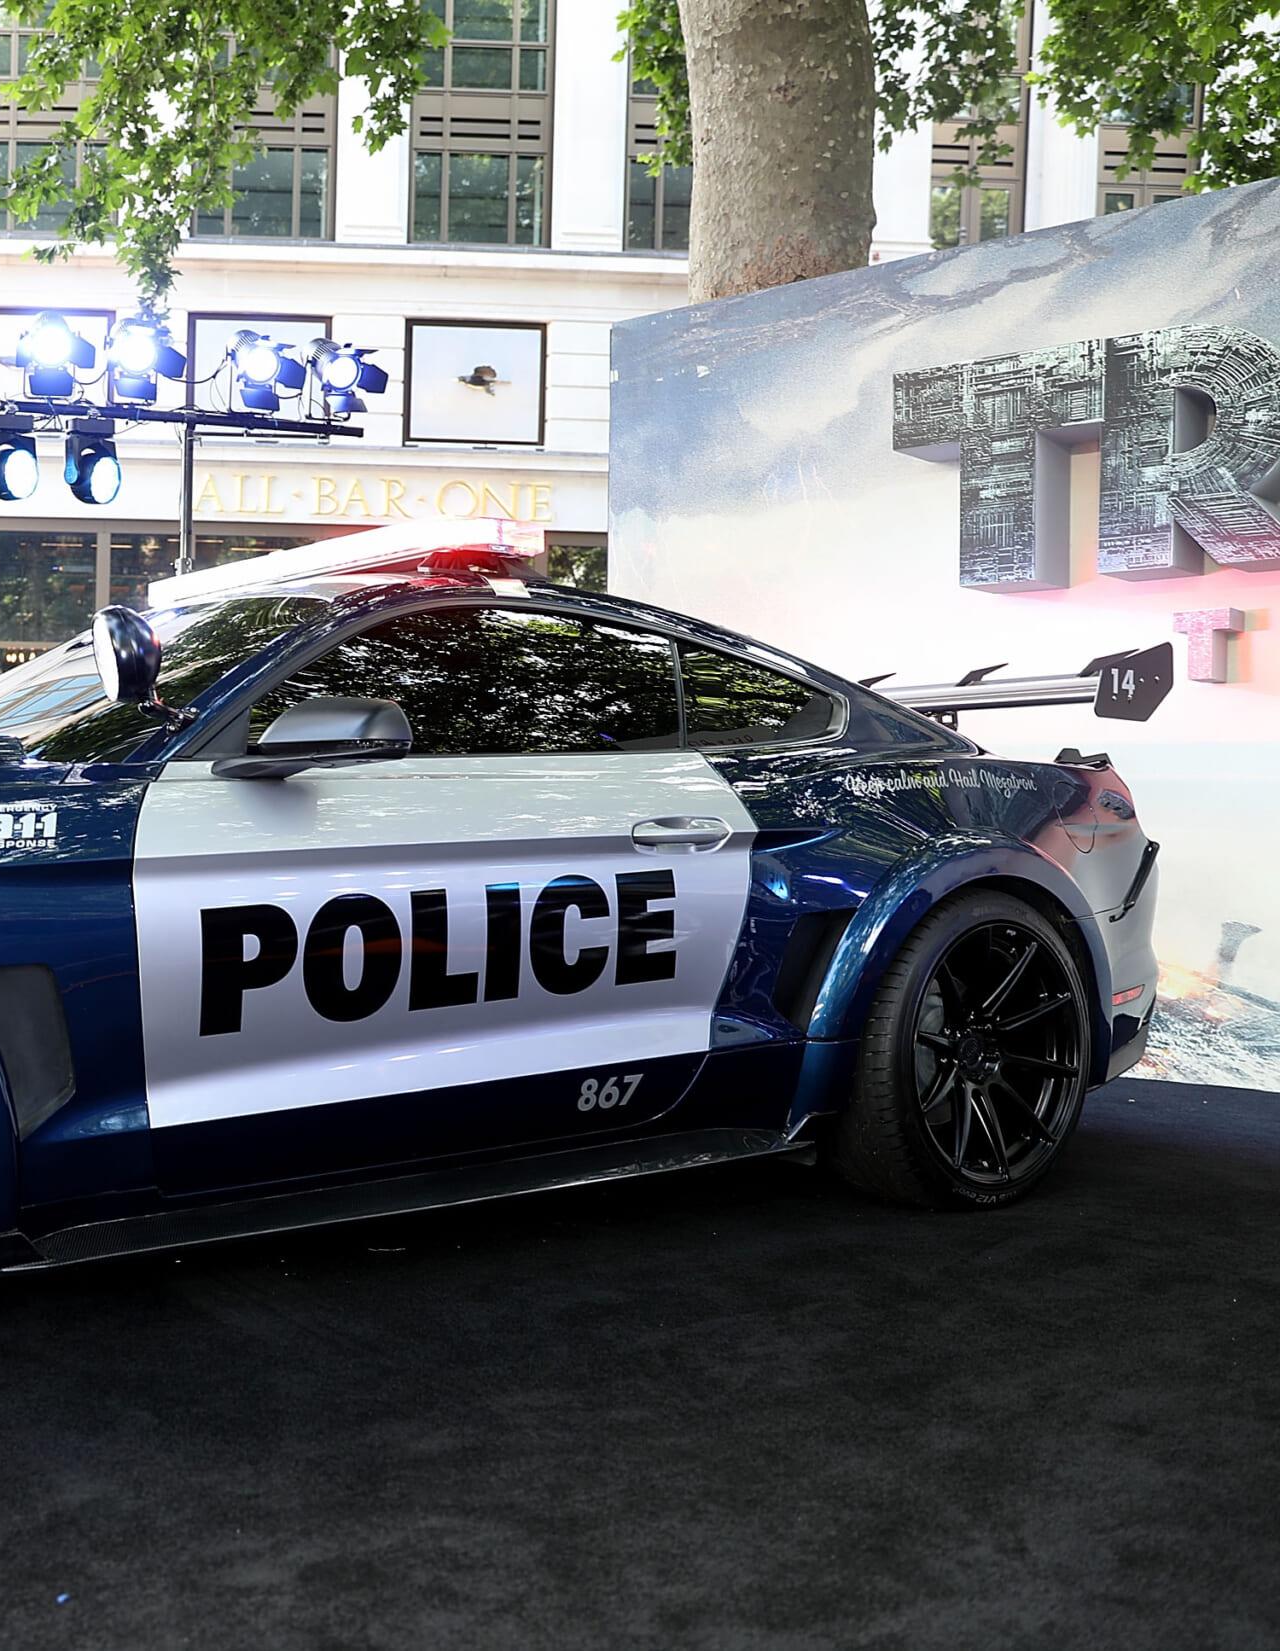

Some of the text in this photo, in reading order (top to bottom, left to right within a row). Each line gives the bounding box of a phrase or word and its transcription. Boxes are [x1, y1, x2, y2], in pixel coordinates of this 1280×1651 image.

[192, 474, 554, 522] ALL BAR ONE
[1111, 668, 1135, 695] 14
[924, 770, 949, 789] and
[948, 769, 981, 789] Hail
[199, 869, 677, 1037] POLICE
[577, 1073, 644, 1112] 867
